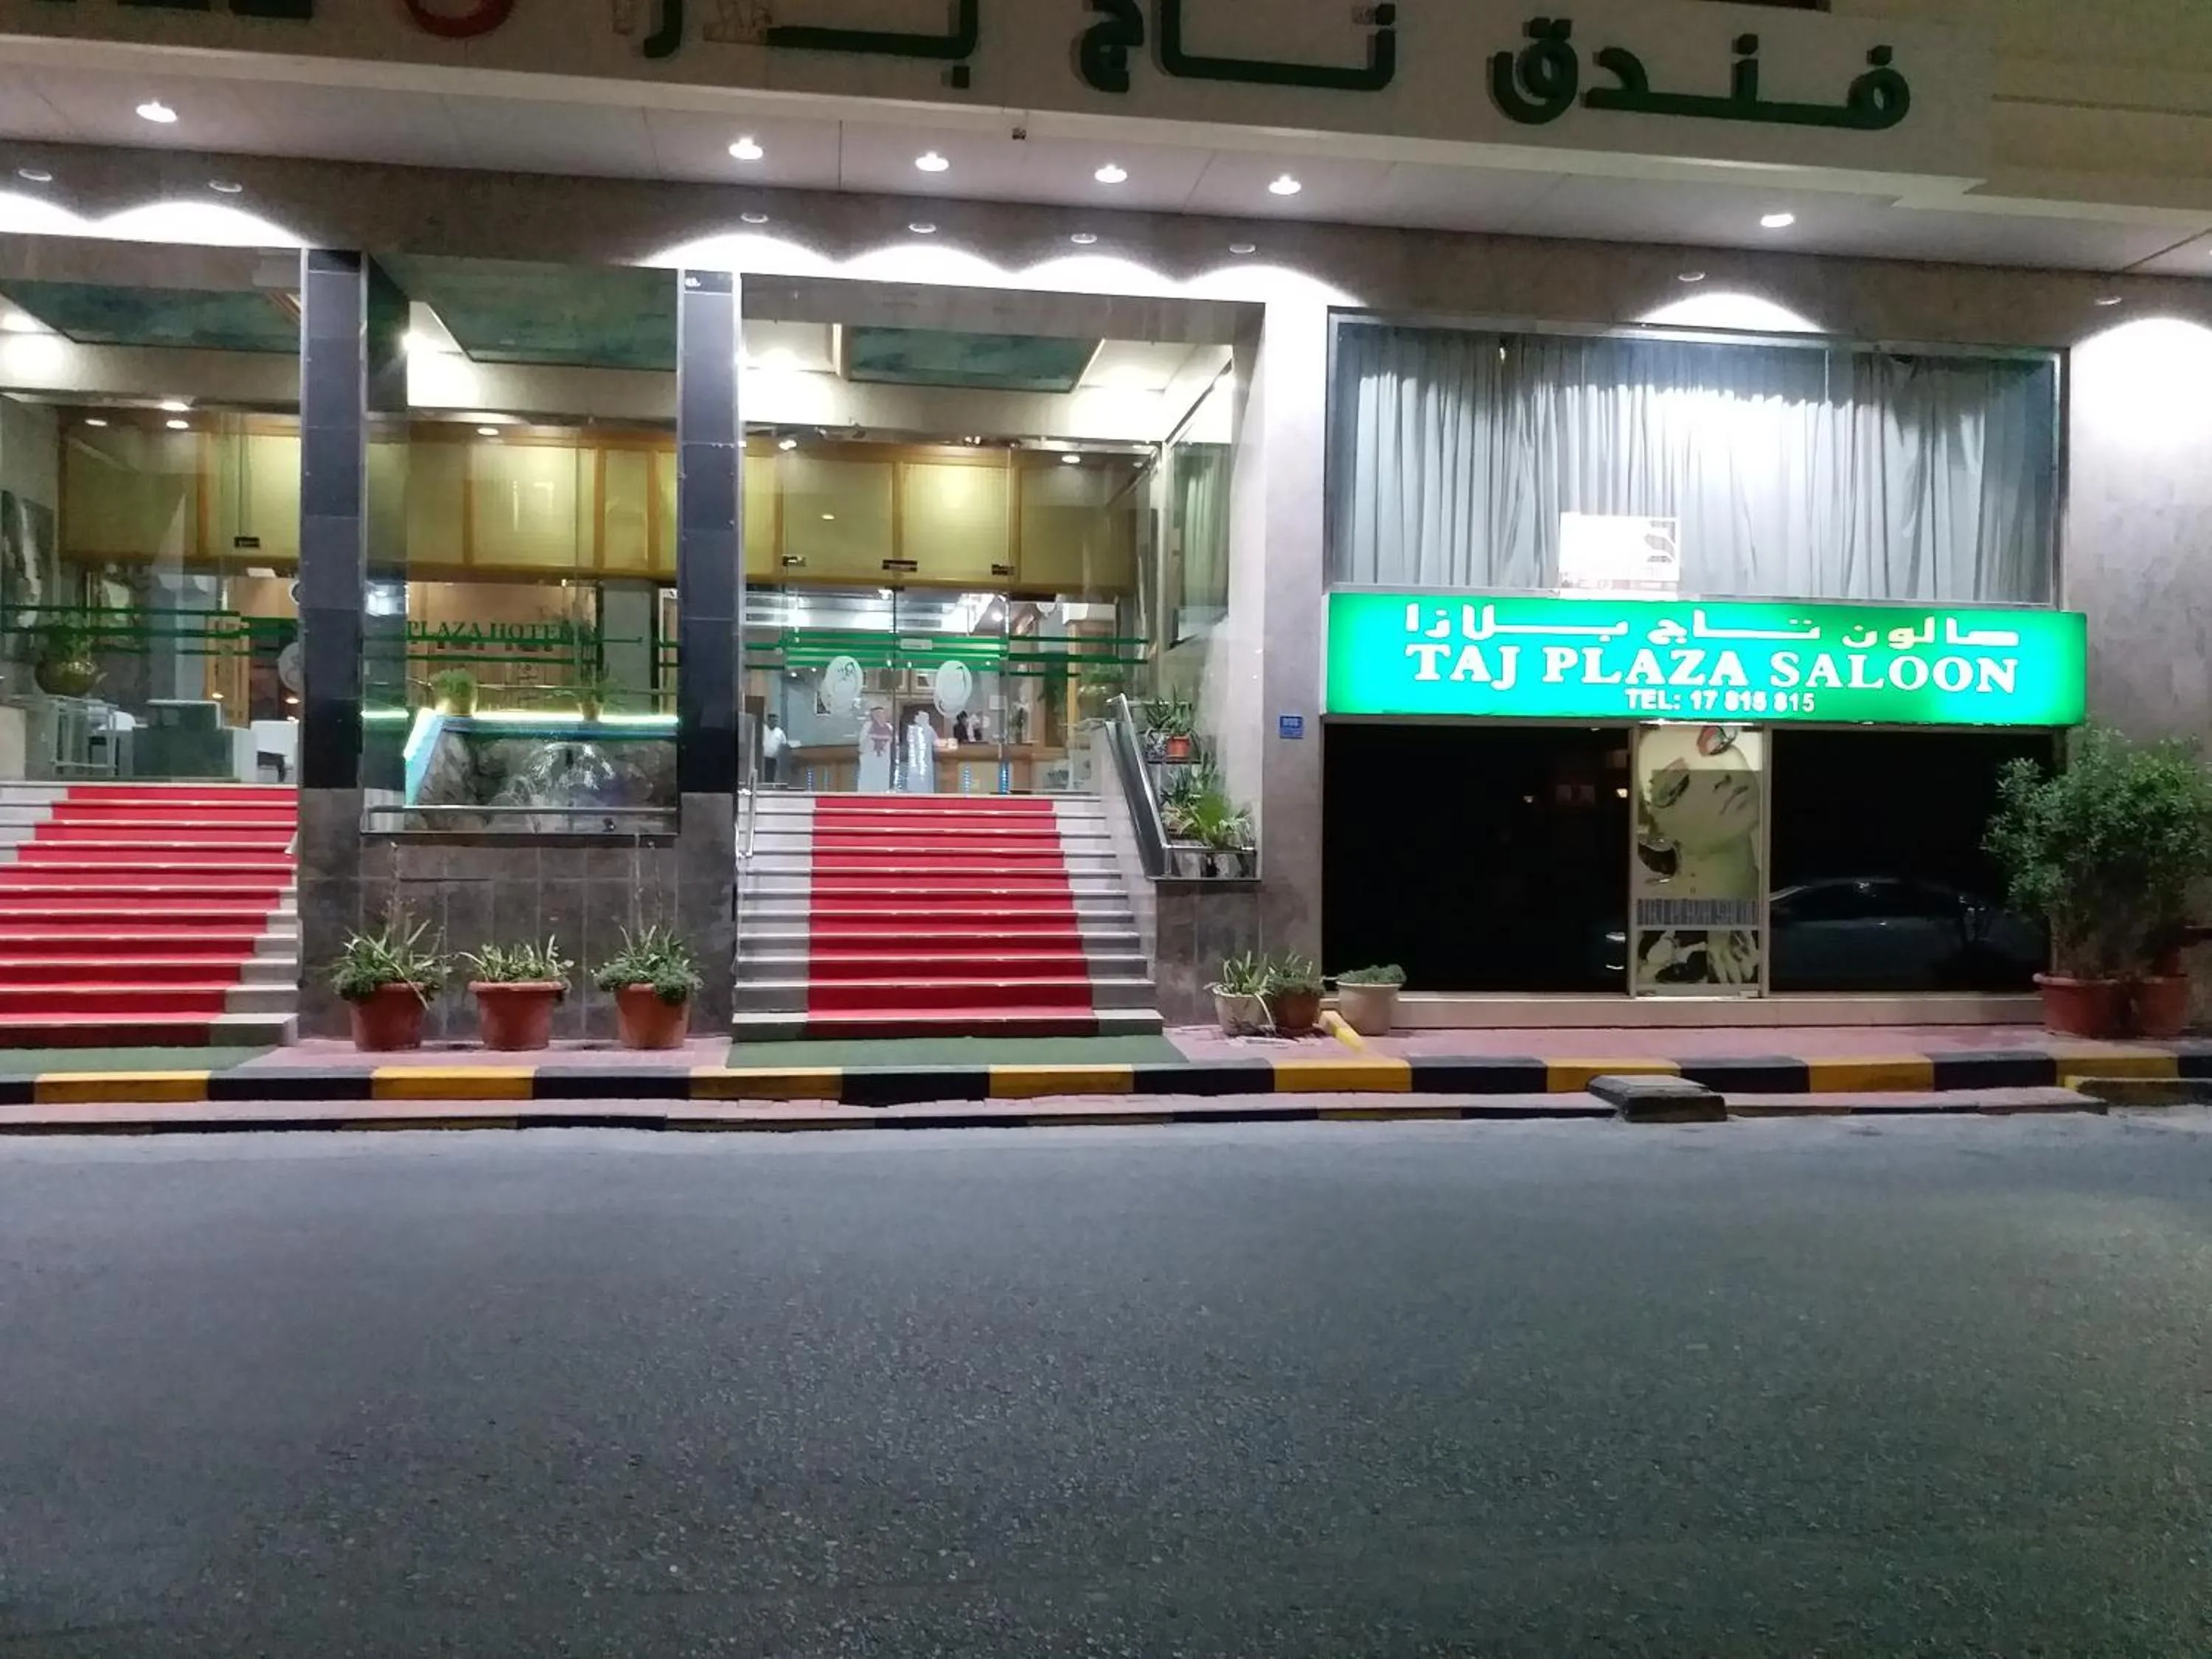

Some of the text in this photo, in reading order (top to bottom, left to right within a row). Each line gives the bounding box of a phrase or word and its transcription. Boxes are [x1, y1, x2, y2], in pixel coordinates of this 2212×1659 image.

[1487, 16, 1910, 131] فندق
[408, 620, 482, 639] PLAZA
[1405, 602, 1629, 641] بلازا
[1647, 609, 1821, 645] تاج
[1405, 643, 2019, 694] TAJ PLAZA SALOON
[1624, 687, 1682, 711] TEL:
[1690, 689, 1719, 711] 17
